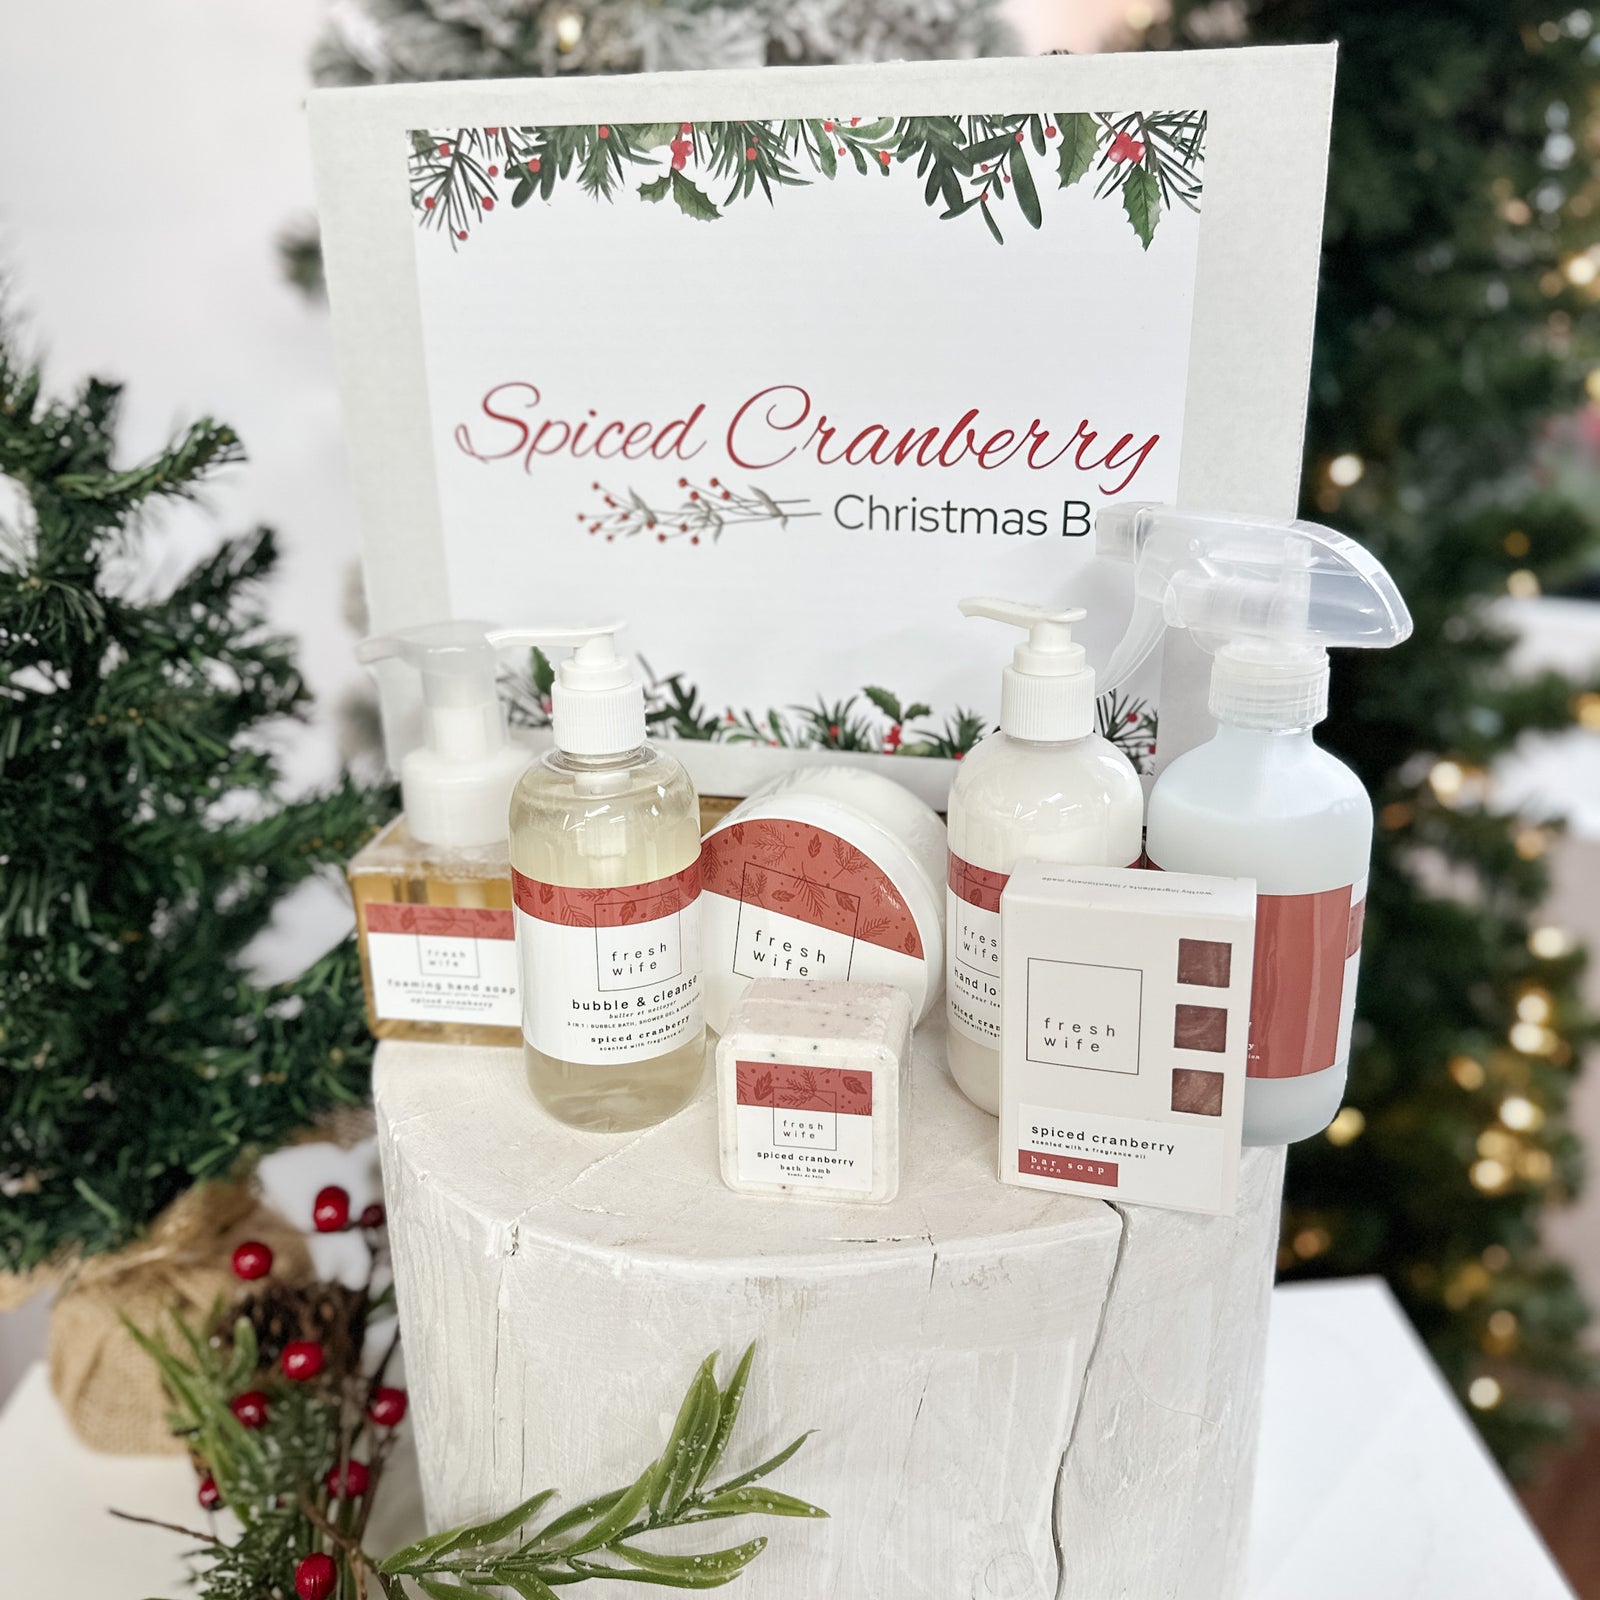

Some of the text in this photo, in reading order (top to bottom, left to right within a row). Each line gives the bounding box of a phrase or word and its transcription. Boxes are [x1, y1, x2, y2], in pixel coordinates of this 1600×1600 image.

[455, 382, 1161, 494] Spiced Cranberry
[833, 493, 1096, 537] Christmas B
[963, 925, 998, 948] fres
[428, 948, 466, 959] fresh
[612, 943, 667, 961] fresh
[756, 929, 826, 964] fresh
[963, 941, 999, 962] wife
[429, 959, 459, 968] wife
[613, 960, 657, 976] wife
[753, 950, 808, 976] wife
[387, 978, 441, 992] foaming
[447, 982, 479, 992] hand
[485, 984, 516, 995] soap
[954, 966, 997, 996] hand lo
[572, 999, 629, 1011] bubble
[637, 997, 646, 1007] &
[653, 974, 697, 1004] cleanse
[591, 1015, 690, 1044] spiced cranberry
[978, 1019, 1000, 1031] cran
[1044, 1017, 1115, 1038] fresh
[1043, 1037, 1100, 1052] wife
[783, 1120, 824, 1131] fresh
[783, 1130, 815, 1139] wife
[1031, 1126, 1175, 1155] spiced cranberry
[757, 1151, 854, 1167] spiced cranberry
[1092, 1147, 1132, 1157] fragrance
[780, 1164, 831, 1175] bath bomb
[1030, 1155, 1105, 1176] bar soap
[1030, 1164, 1061, 1174] savon
